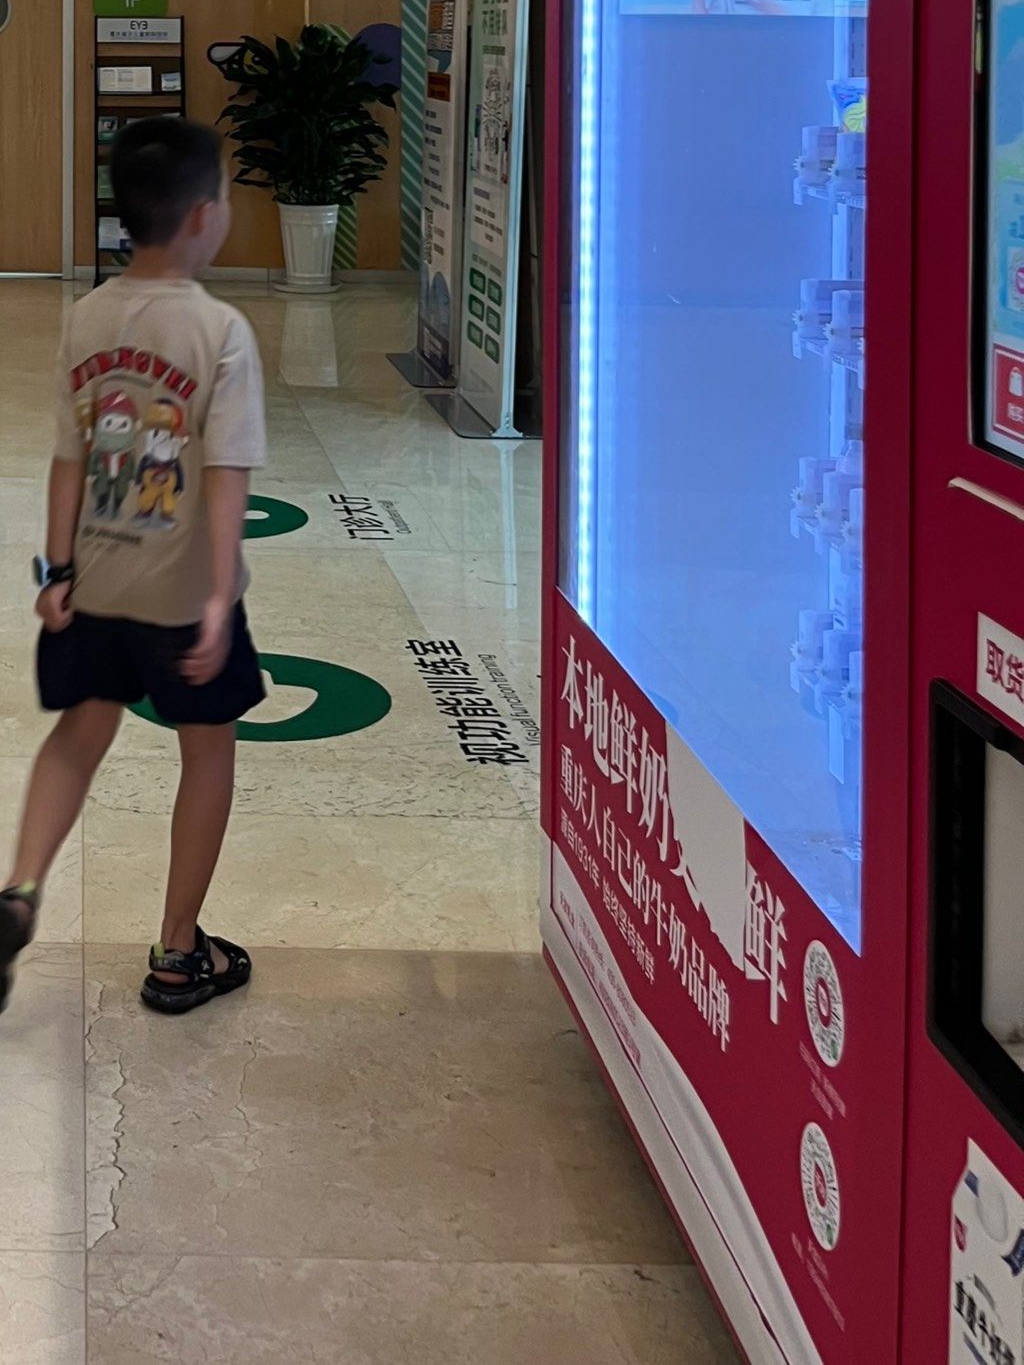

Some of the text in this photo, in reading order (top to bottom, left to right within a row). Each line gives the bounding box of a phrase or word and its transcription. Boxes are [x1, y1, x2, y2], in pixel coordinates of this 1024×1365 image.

[328, 493, 395, 541] 门诊大厅
[405, 639, 530, 766] 视功能训练室
[477, 654, 508, 683] training
[496, 683, 531, 717] function
[560, 634, 788, 1025] 本地鲜奶鲜
[560, 742, 732, 1052] 重庆人自己的牛奶品牌
[602, 875, 656, 985] 始终坚持新鲜
